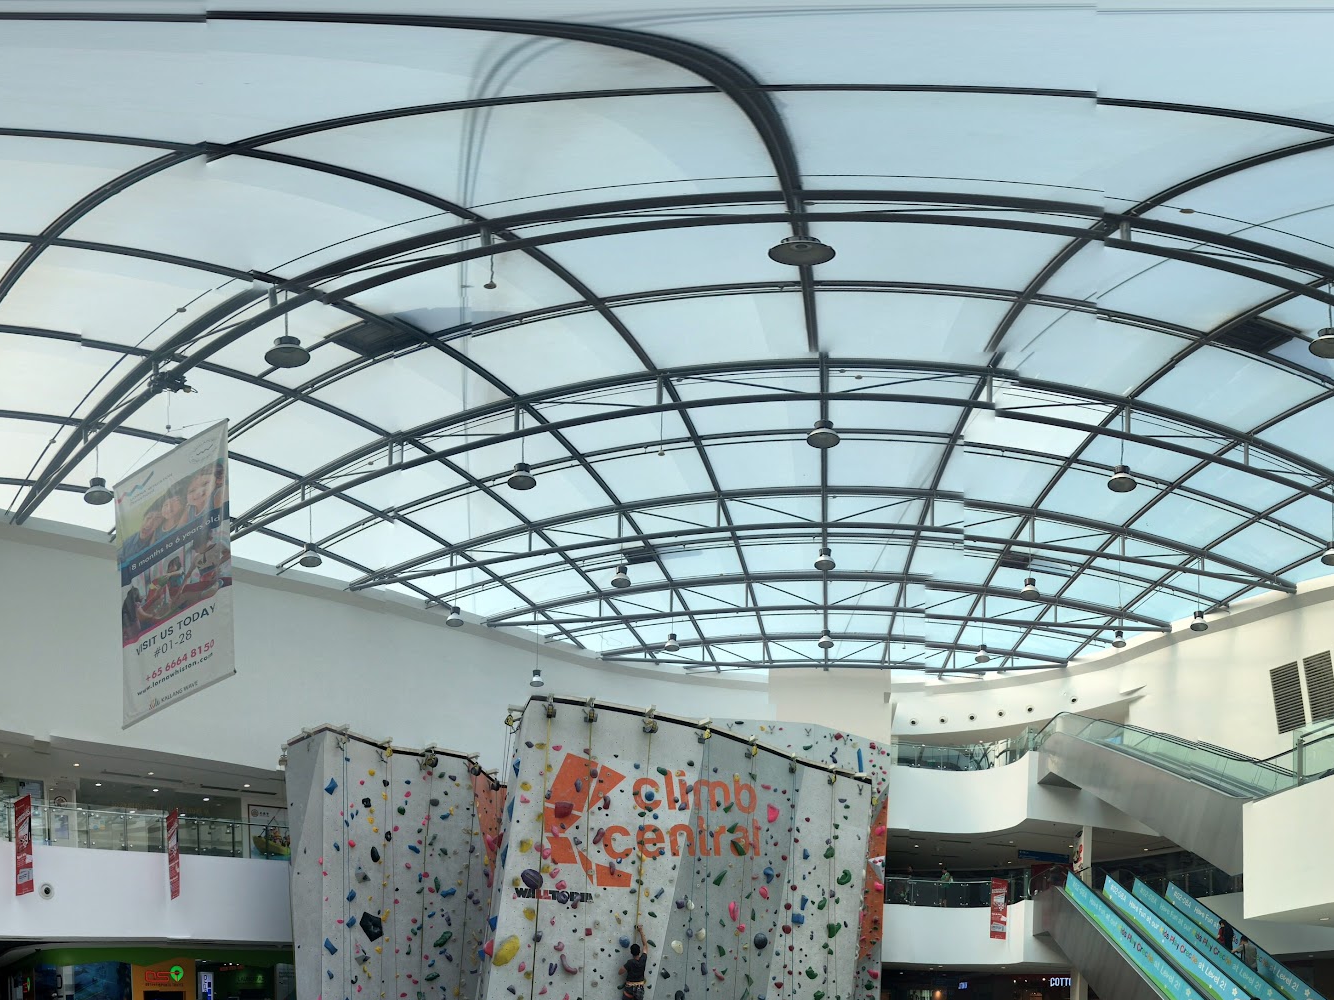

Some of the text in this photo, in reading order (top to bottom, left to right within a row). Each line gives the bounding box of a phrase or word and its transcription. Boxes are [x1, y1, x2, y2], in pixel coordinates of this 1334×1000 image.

[138, 515, 220, 566] months to 6 years old
[136, 603, 216, 656] VISIT US TODAY
[154, 629, 193, 658] #01-28
[146, 639, 215, 682] +65 6664 8150
[632, 769, 758, 814] climb
[602, 815, 761, 860] central
[1138, 908, 1146, 918] Fun
[1198, 962, 1205, 972] at
[1204, 966, 1220, 985] Level
[1220, 981, 1227, 991] 2!
[1194, 906, 1205, 918] Have
[1205, 914, 1213, 924] Fun
[1276, 968, 1292, 987] Level
[1292, 982, 1299, 992] 2!
[1160, 966, 1174, 984] Level
[1232, 963, 1239, 972] at
[1239, 968, 1255, 986] Level
[1254, 981, 1262, 991] 2!
